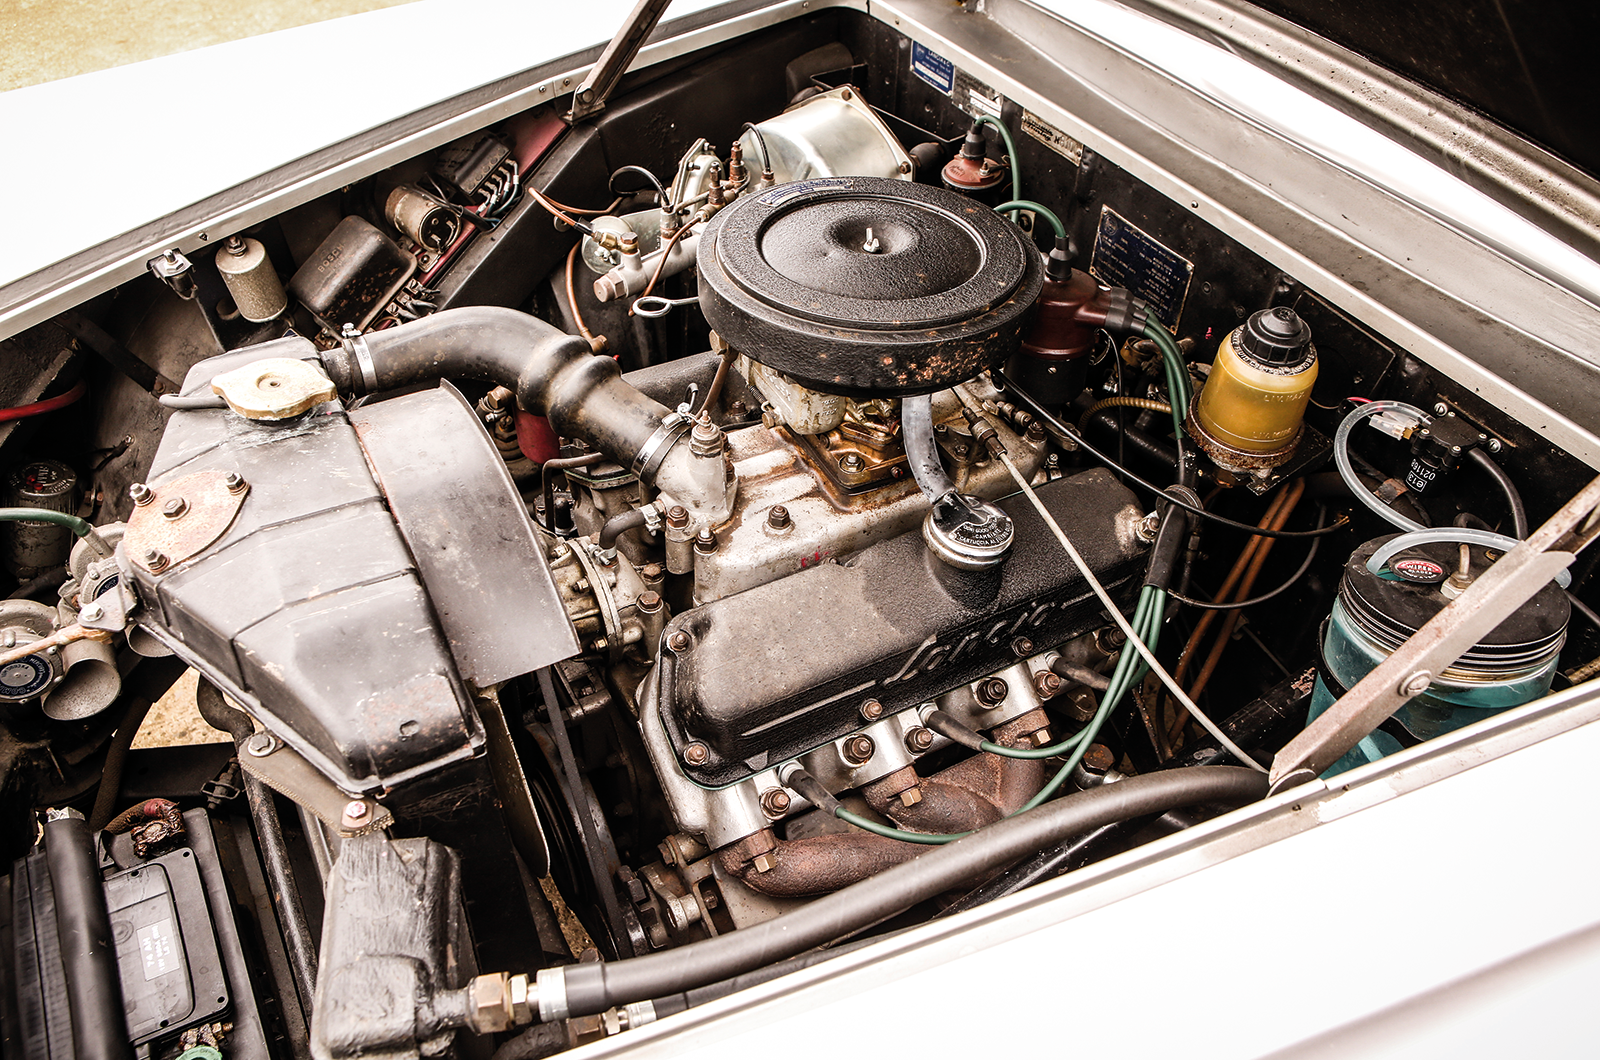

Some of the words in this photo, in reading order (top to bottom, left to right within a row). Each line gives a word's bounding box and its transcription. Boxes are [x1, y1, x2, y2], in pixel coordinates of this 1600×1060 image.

[317, 243, 345, 273] BOSCH
[1408, 473, 1424, 488] e13
[1406, 564, 1432, 572] WIPER
[143, 937, 152, 951] AH
